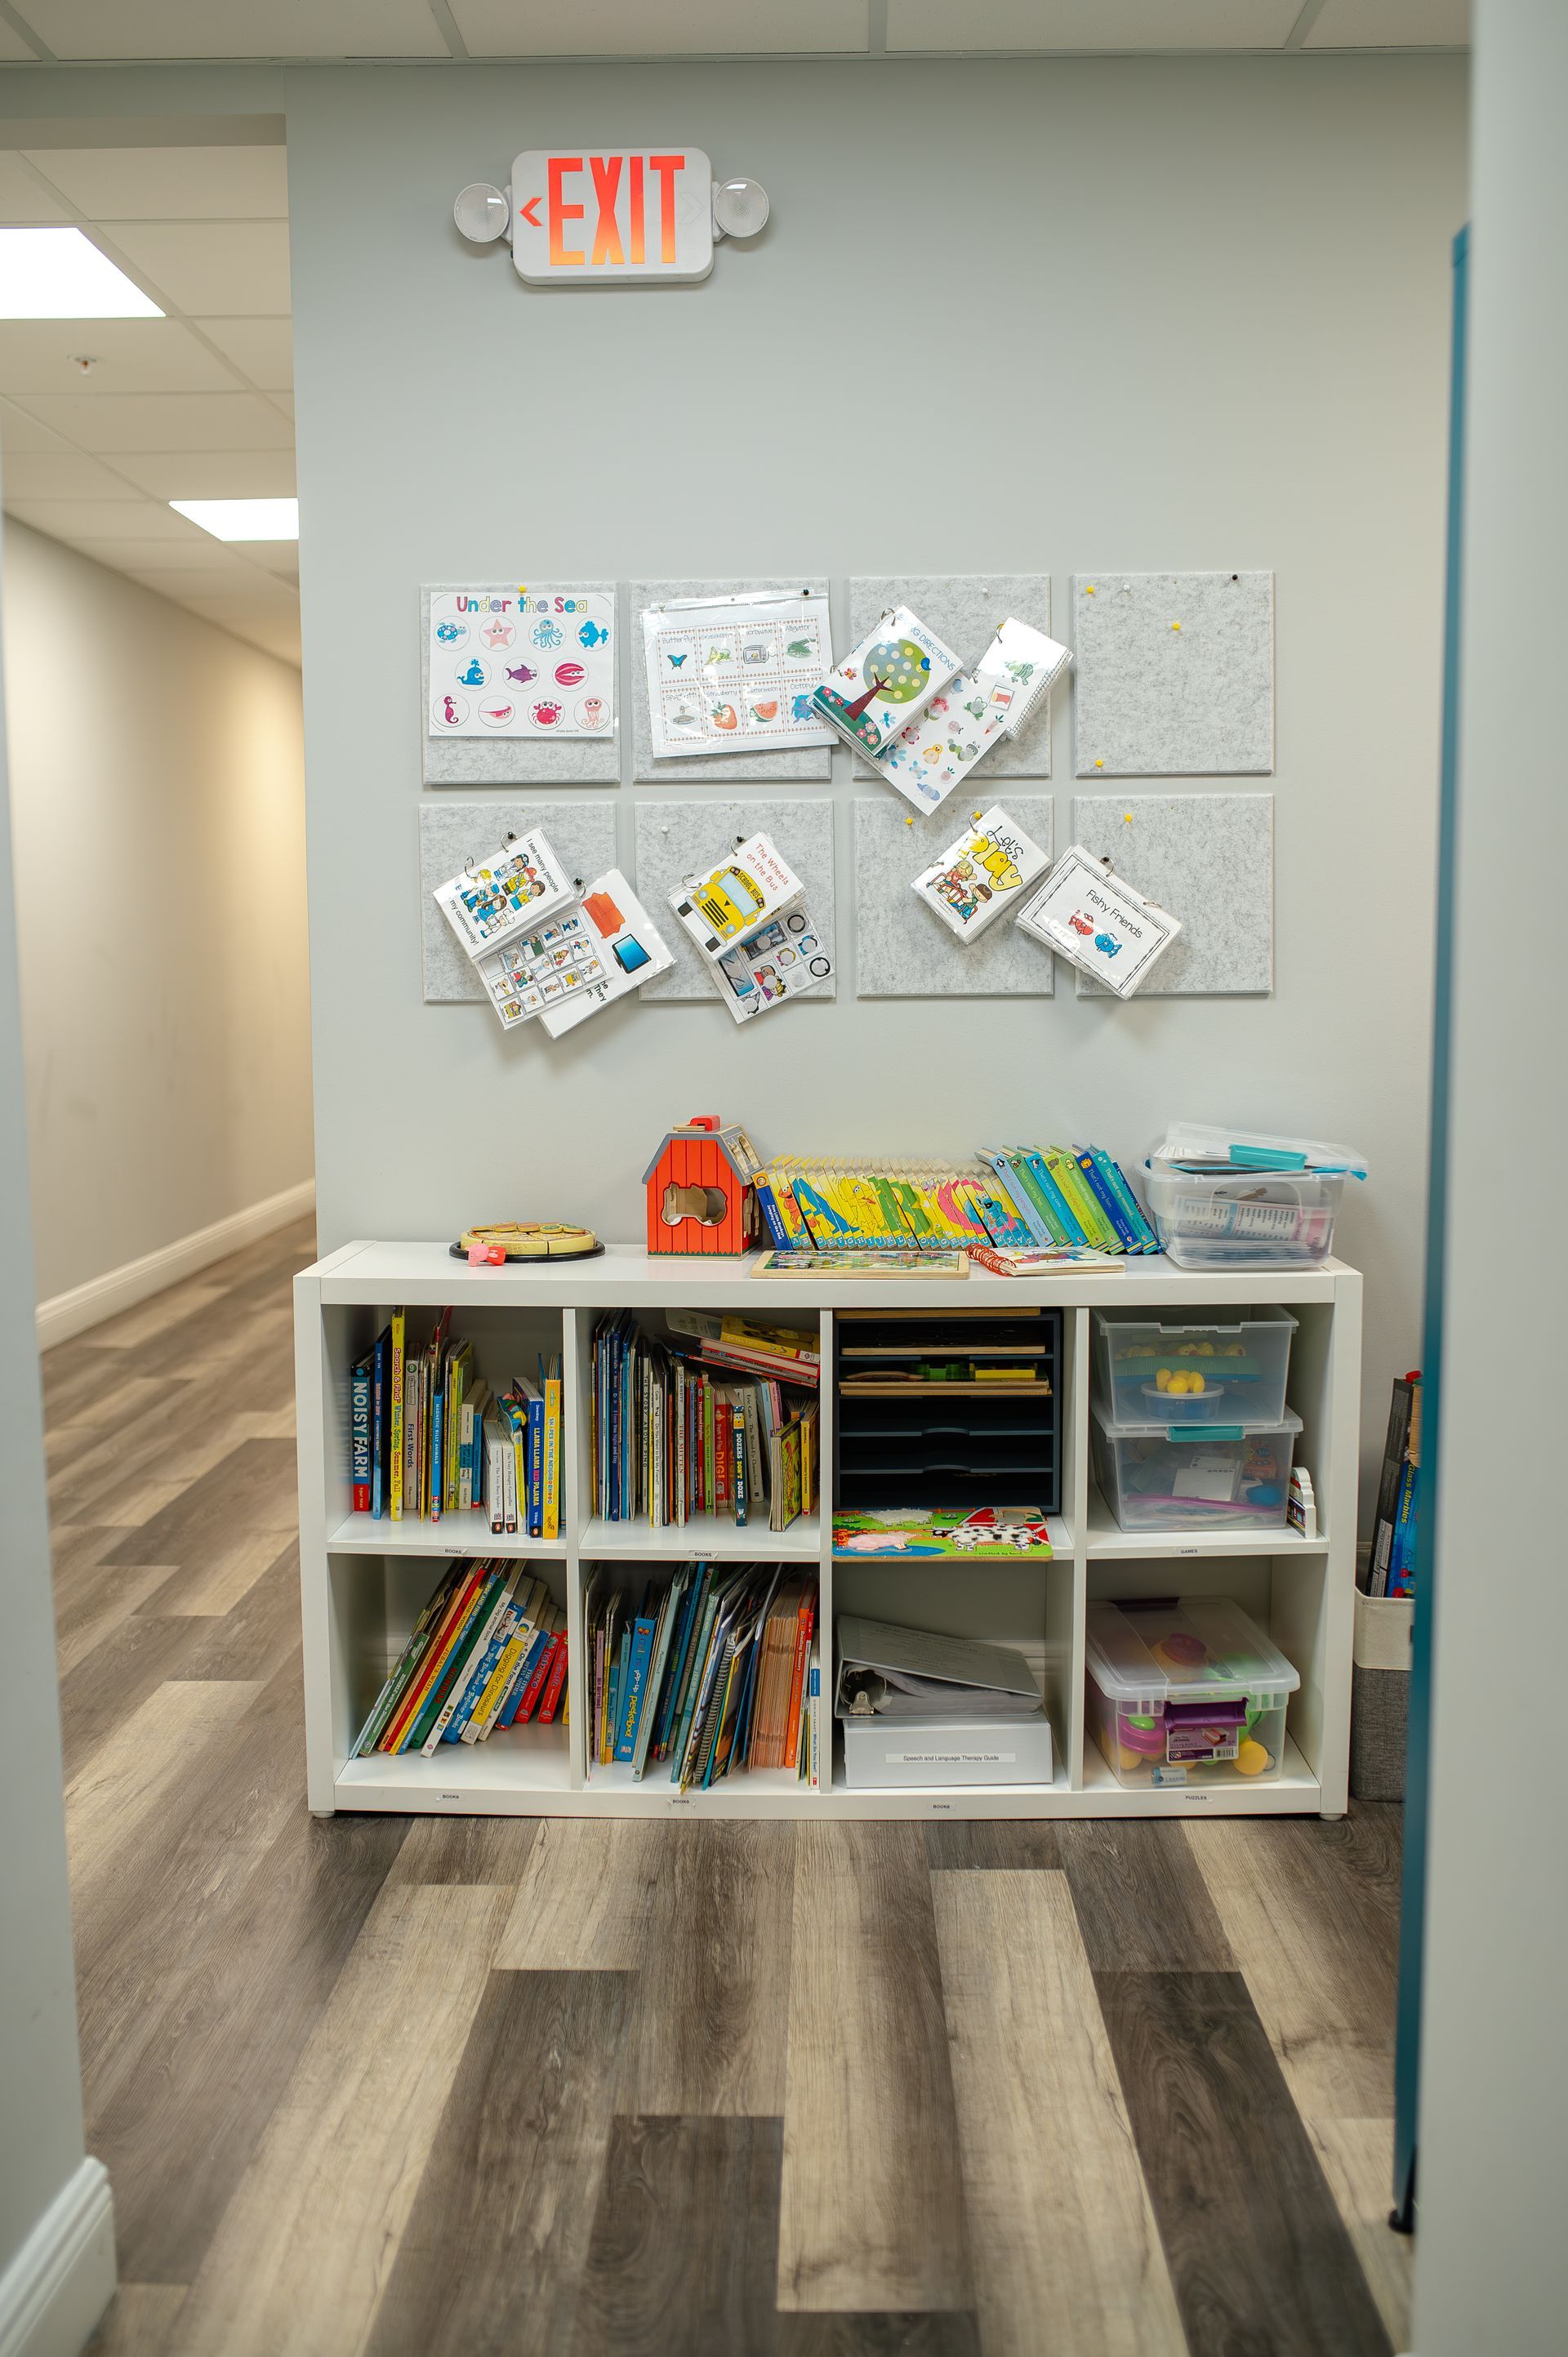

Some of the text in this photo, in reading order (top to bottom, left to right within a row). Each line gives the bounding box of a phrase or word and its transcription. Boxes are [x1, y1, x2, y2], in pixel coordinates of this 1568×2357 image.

[547, 155, 685, 265] EXIT
[457, 595, 587, 613] Under the Sea
[662, 635, 693, 645] Butterfly
[785, 624, 812, 633] Alligator
[918, 633, 956, 671] DIRECTIONS
[987, 826, 1024, 860] Let's
[528, 842, 537, 853] see
[533, 853, 546, 871] many
[542, 871, 559, 893] people
[746, 853, 779, 891] on the Bus
[755, 842, 790, 885] The Wheels
[737, 871, 760, 898] SCHOOL BUS
[448, 899, 479, 946] my community!
[1085, 889, 1143, 939] Fishy Friends
[591, 983, 608, 1002] They
[1088, 1167, 1099, 1183] That's
[1099, 1190, 1107, 1199] my
[354, 1382, 367, 1477] NOISY FARM
[393, 1428, 401, 1450] Spring,
[715, 1451, 724, 1478] DIG!
[1401, 1464, 1414, 1523] Glass Marbles
[483, 1581, 492, 1595] LOOK
[471, 1605, 479, 1616] FIND
[477, 1594, 485, 1606] AND
[488, 1615, 497, 1630] animal
[424, 1597, 474, 1691] WOOD WOOD JUBAL'S WISH
[483, 1630, 491, 1641] book
[479, 1662, 488, 1673] Blue
[484, 1651, 493, 1662] BIG
[518, 1652, 525, 1661] On
[473, 1672, 483, 1685] Book
[477, 1646, 516, 1717] Digging for Dinosaurs
[506, 1671, 516, 1686] Farm
[511, 1677, 523, 1696] SPIDER
[519, 1668, 532, 1692] THE ITSY
[458, 1690, 474, 1713] Beginner
[624, 1669, 641, 1737] pop-up peekaboo!
[452, 1713, 463, 1729] Books
